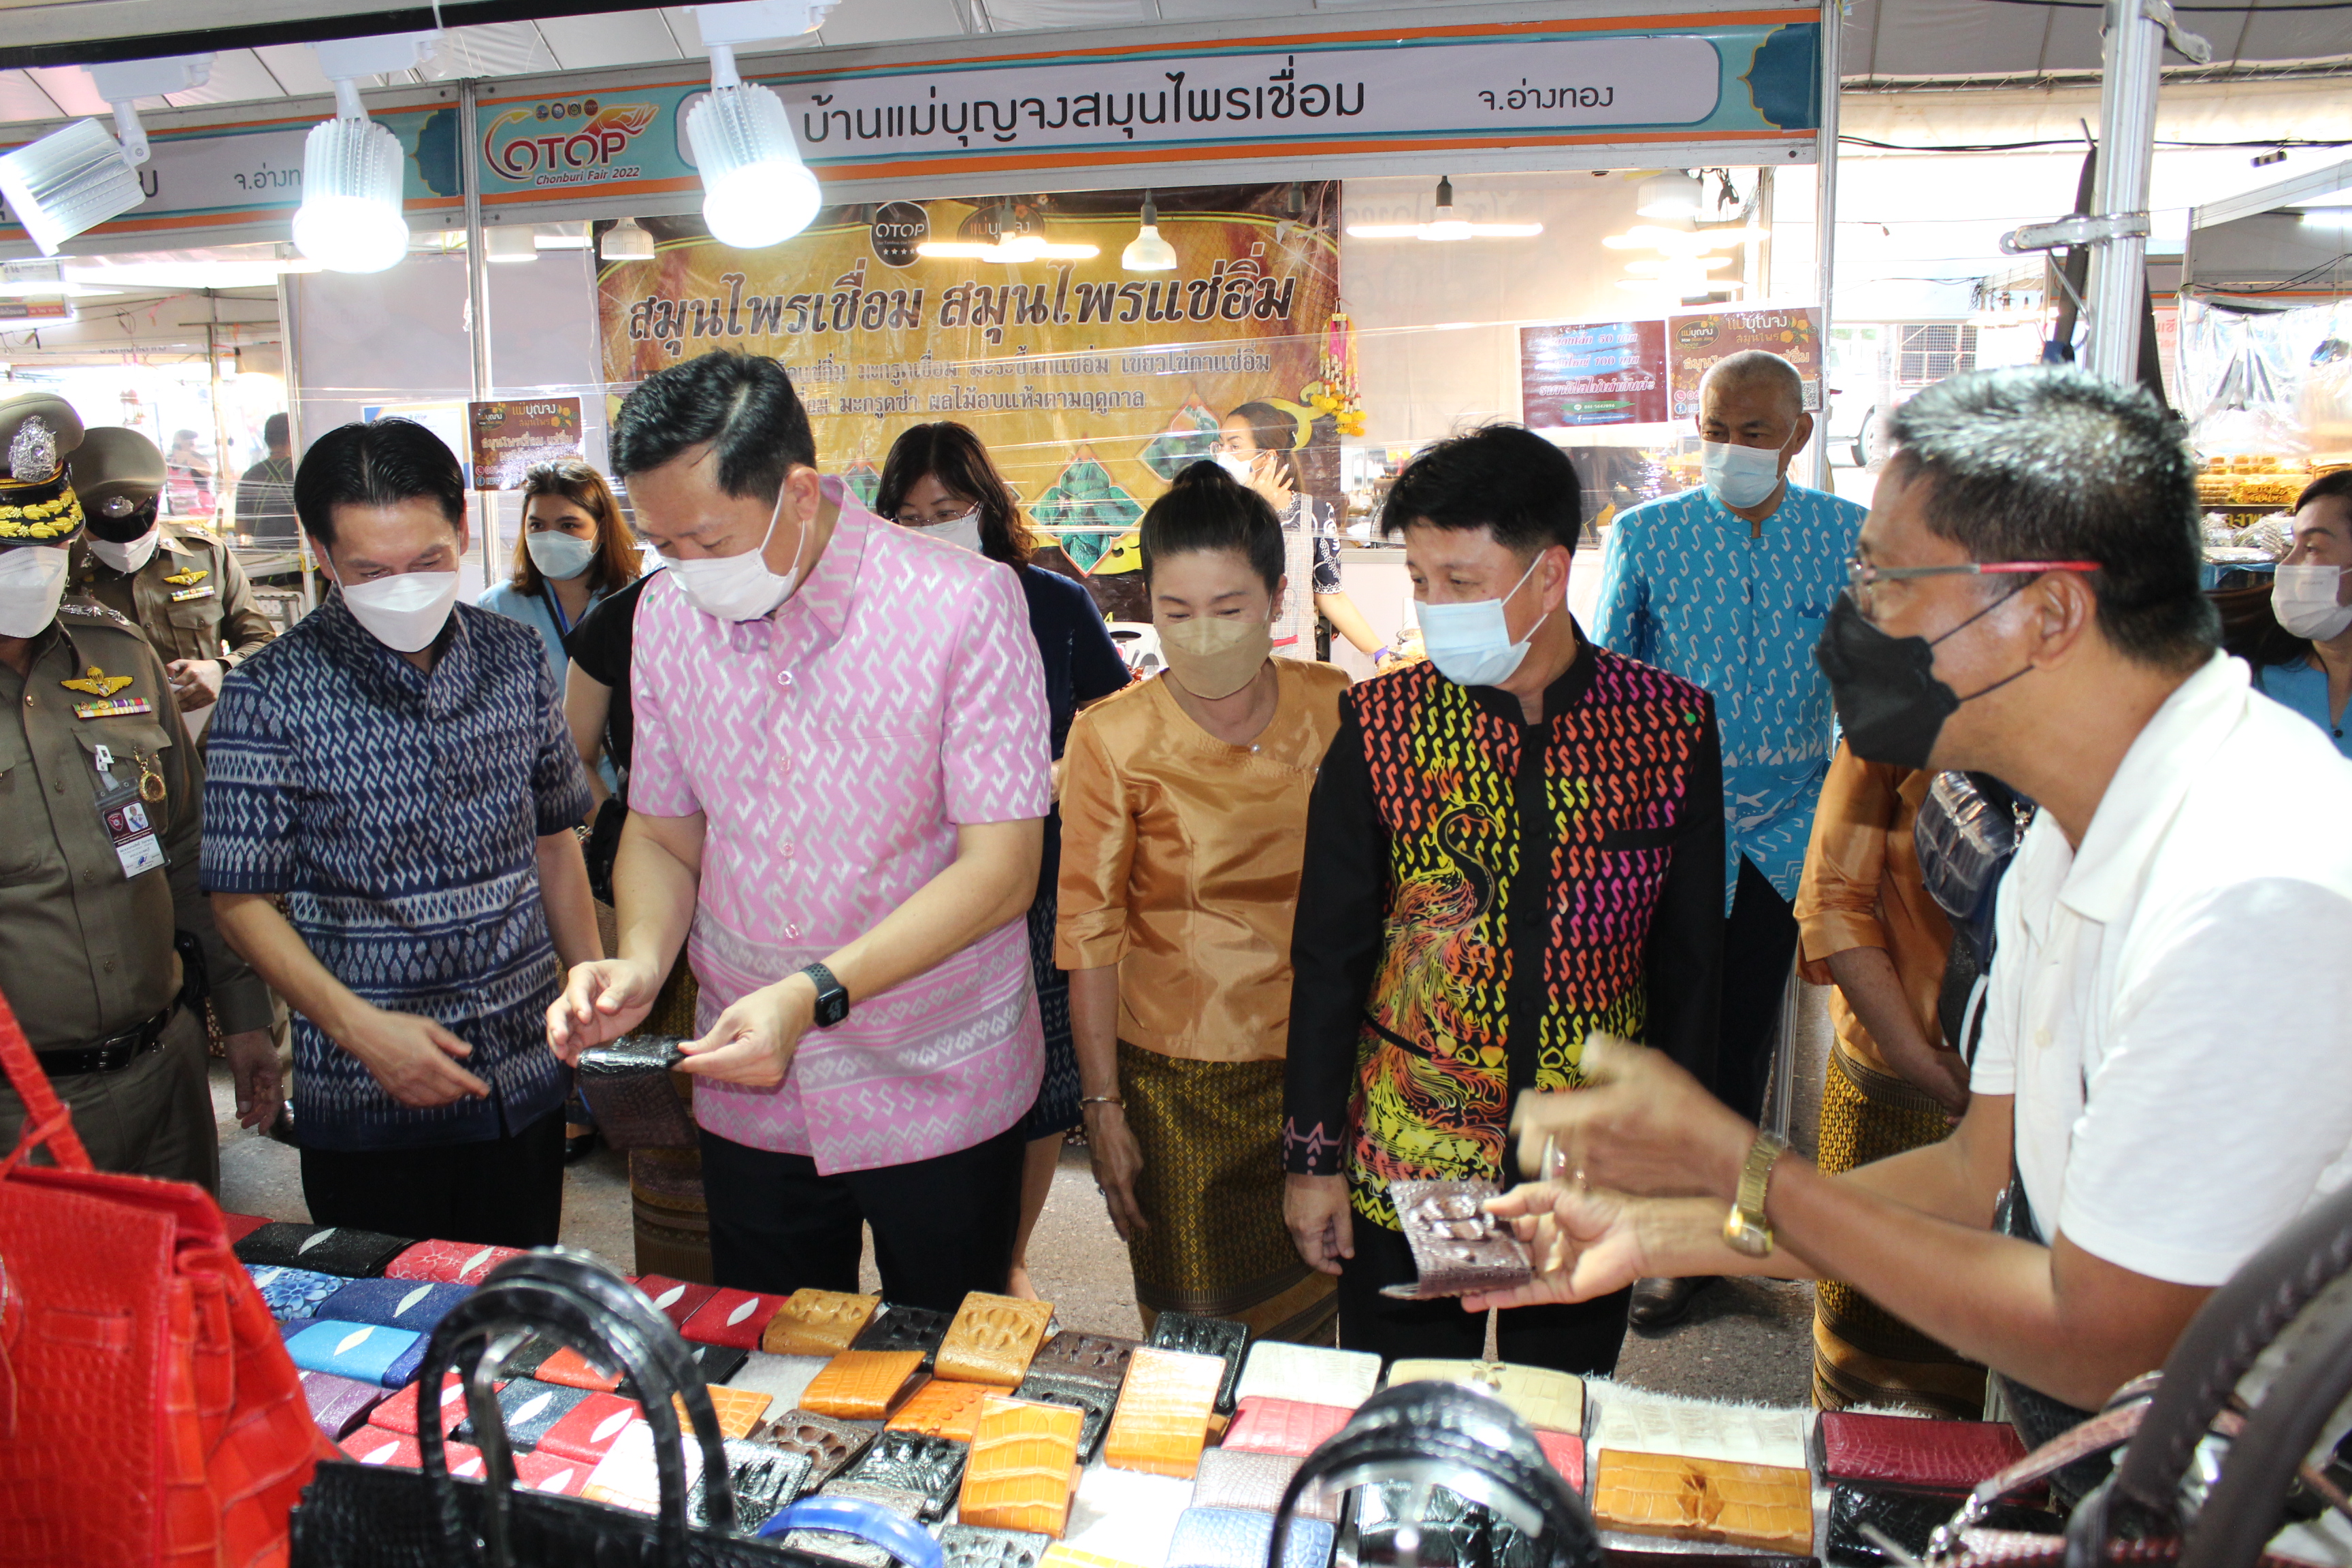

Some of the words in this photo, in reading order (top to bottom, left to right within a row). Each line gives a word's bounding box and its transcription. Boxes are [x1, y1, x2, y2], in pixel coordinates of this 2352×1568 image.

[804, 54, 1365, 148] บ้านแม่บุญจงสมุนไพรเชื่อม
[1478, 78, 1614, 111] จ.อ่างทอง
[504, 132, 626, 172] OTOP
[233, 163, 301, 191] จ.อ่างท
[536, 171, 584, 185] Chonburi
[587, 169, 608, 180] Fair
[612, 167, 640, 179] 2022
[875, 223, 925, 238] OTOP
[970, 215, 1031, 242] แม่บุจง
[628, 257, 924, 357] สมุนไพรเชื่อม
[938, 242, 1296, 345] สมุนไพรแช่อิ่ม
[1598, 334, 1614, 344] 50
[1617, 333, 1639, 344] บาท
[1681, 325, 1714, 337] แม่บุญจง
[1735, 332, 1779, 345] สมุนไพร
[1122, 342, 1271, 374] เขียวไข่กาแช่อิ่ม
[1595, 355, 1616, 366] 100
[1619, 355, 1640, 365] บาท
[512, 402, 556, 419] แม่บุญจง
[839, 389, 919, 420] มะกรูดซ่า
[928, 385, 1145, 416] ผลไม้อบแห้งตามฤดูกาล
